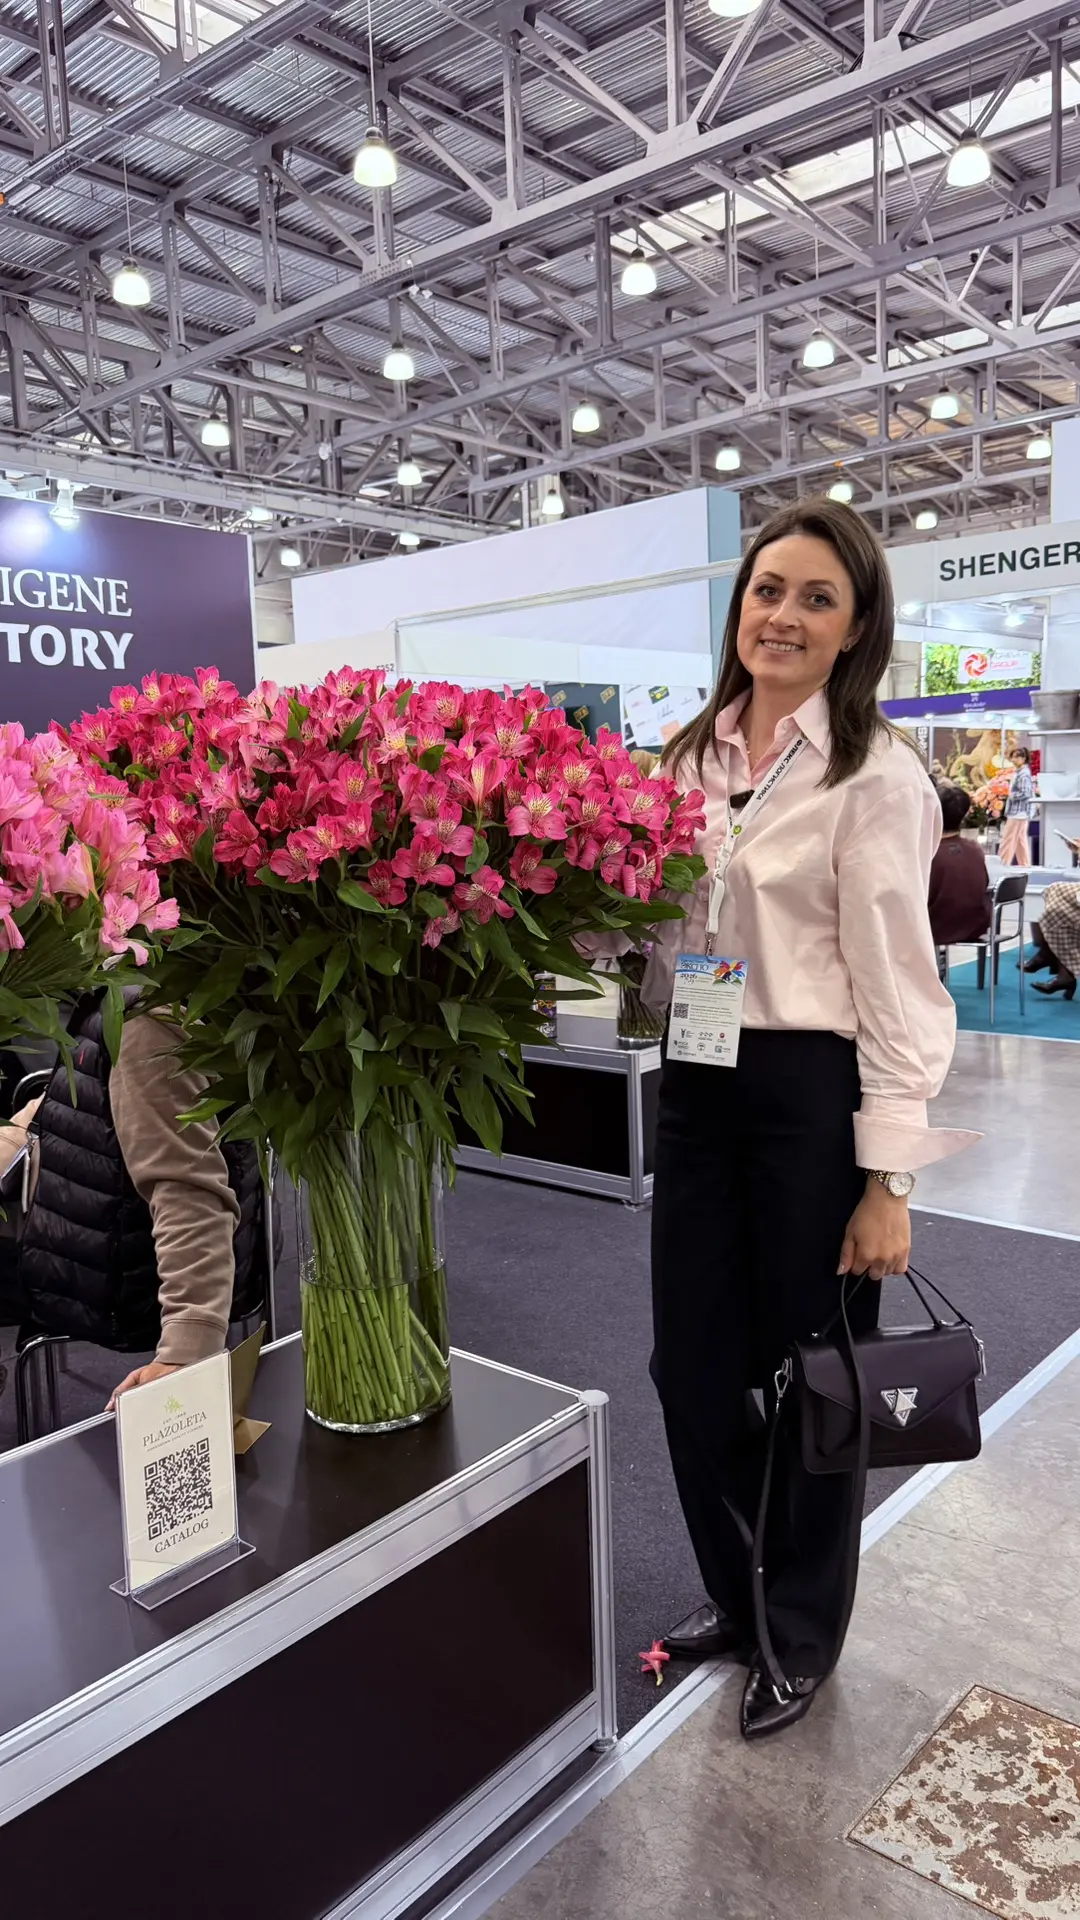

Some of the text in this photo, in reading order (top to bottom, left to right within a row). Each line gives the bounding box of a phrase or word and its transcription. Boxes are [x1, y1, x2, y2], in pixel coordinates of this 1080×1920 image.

[939, 541, 1080, 582] SHENGER
[0, 622, 134, 670] TORY
[756, 739, 803, 801] ФЛЕКС ЛОГИСТИКА
[142, 1411, 207, 1447] PLAZOLETA
[154, 1518, 209, 1553] CATALOG
